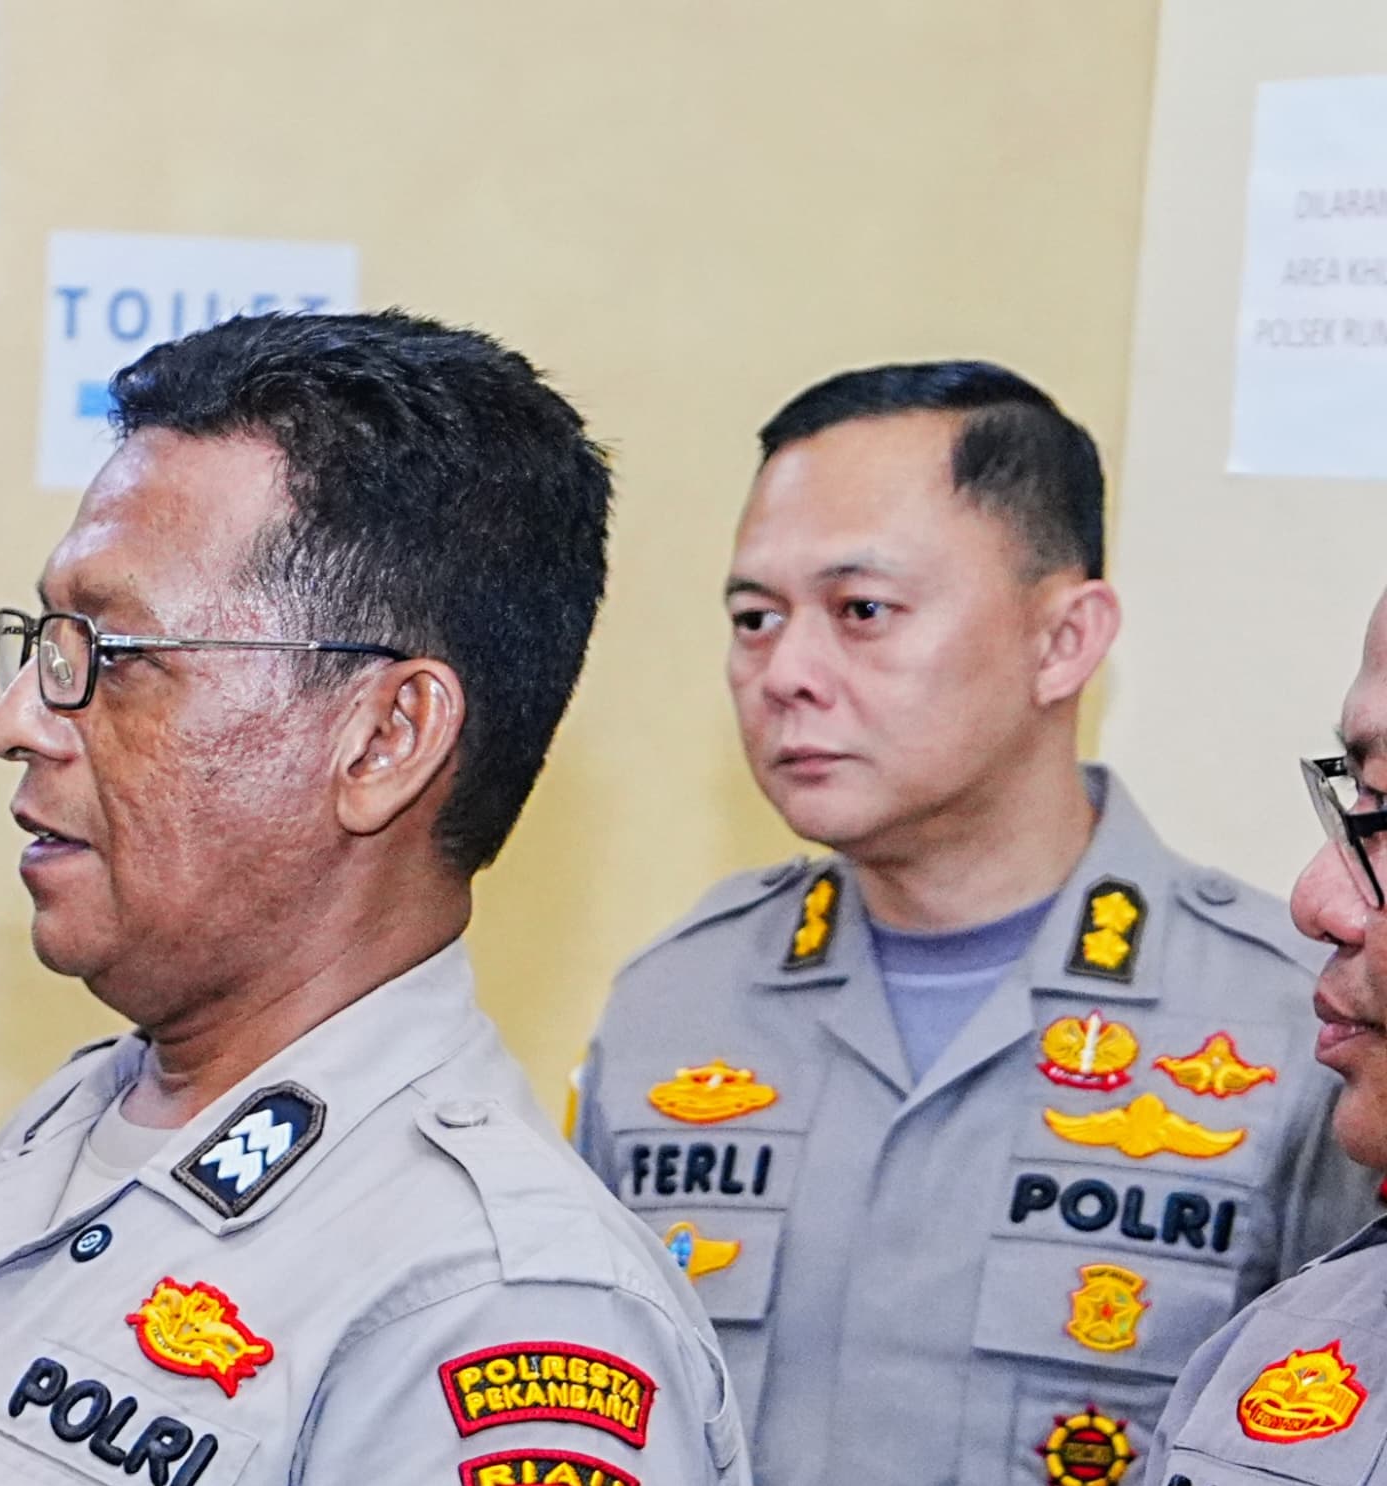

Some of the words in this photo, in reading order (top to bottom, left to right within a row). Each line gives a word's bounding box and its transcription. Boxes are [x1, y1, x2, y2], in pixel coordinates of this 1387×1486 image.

[1281, 256, 1341, 286] AREA
[56, 286, 329, 342] TOI
[1254, 317, 1336, 347] POLSEK
[632, 1142, 773, 1196] FERLI
[1009, 1172, 1238, 1254] POLRI
[456, 1354, 641, 1401] POLRESTA
